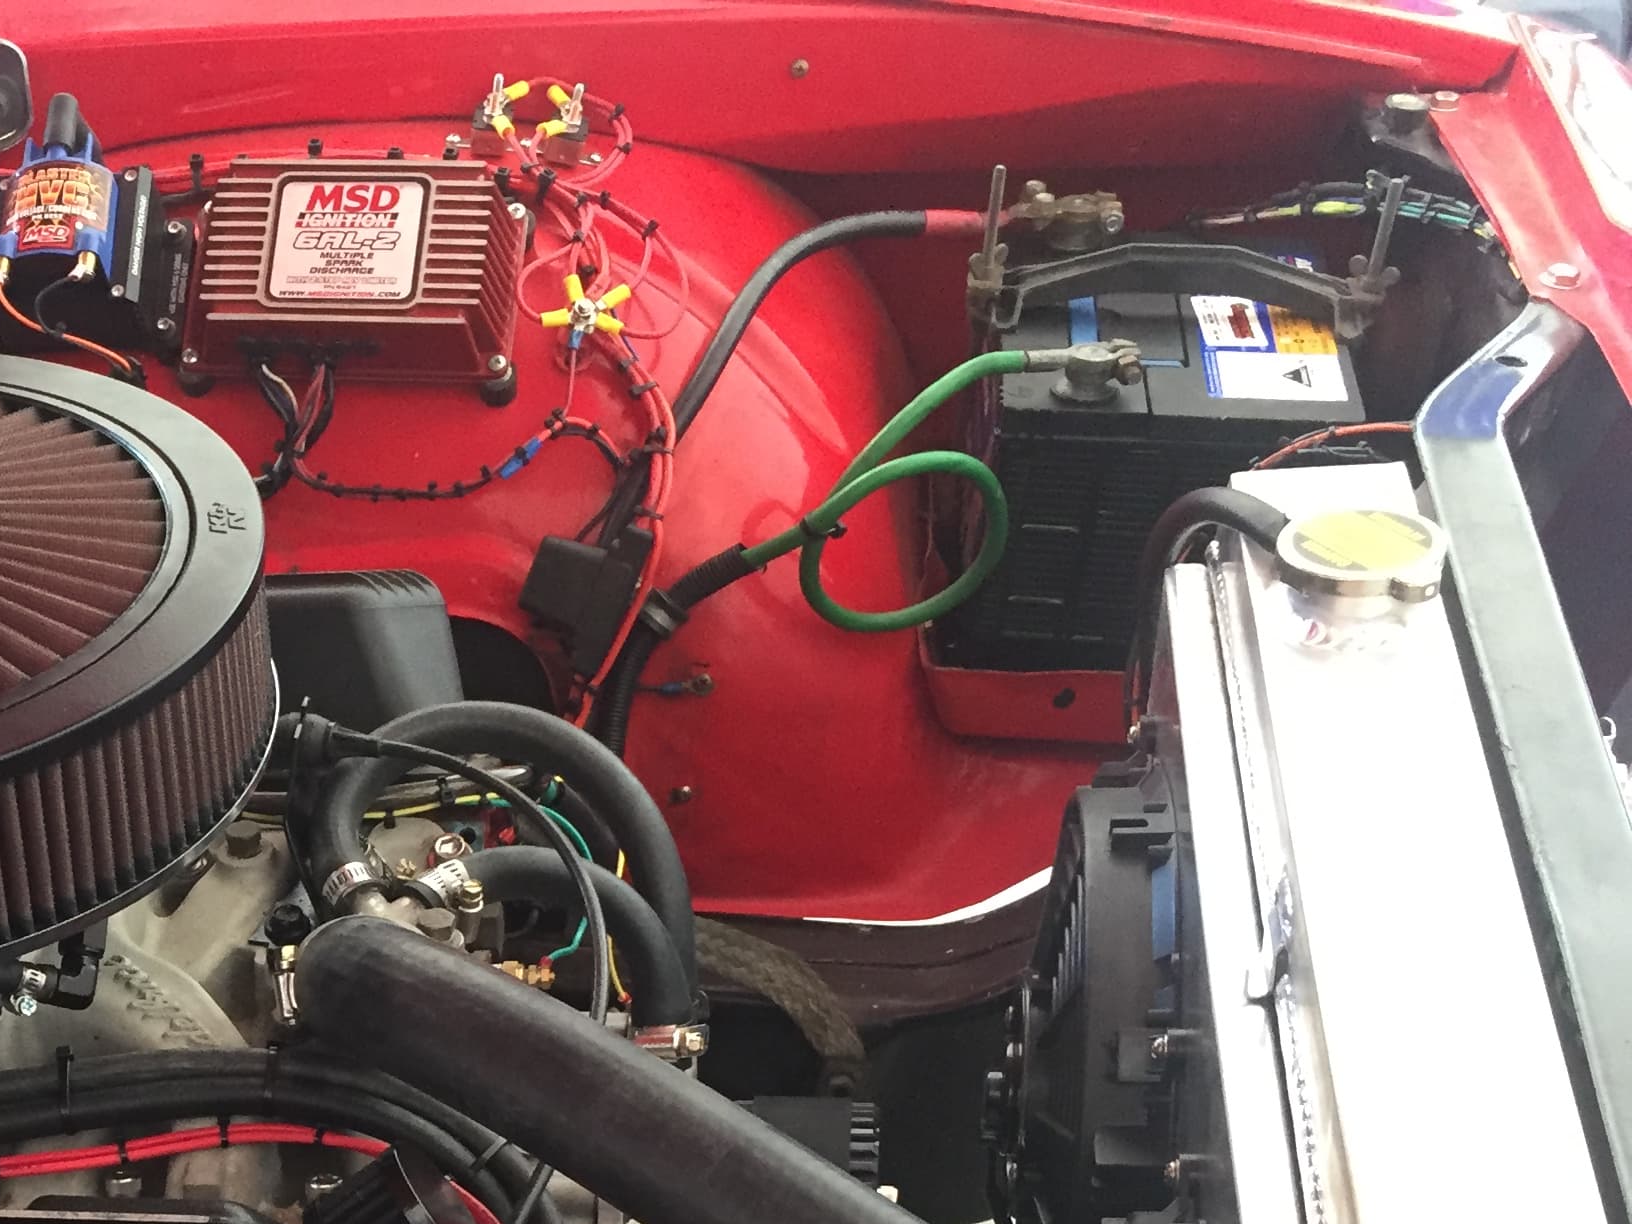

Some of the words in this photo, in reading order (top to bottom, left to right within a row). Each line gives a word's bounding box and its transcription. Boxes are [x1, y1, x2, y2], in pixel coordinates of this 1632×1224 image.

[305, 184, 400, 212] MSD
[302, 213, 392, 228] IGNITION
[23, 225, 70, 240] MSD
[293, 230, 401, 250] 6AL-2
